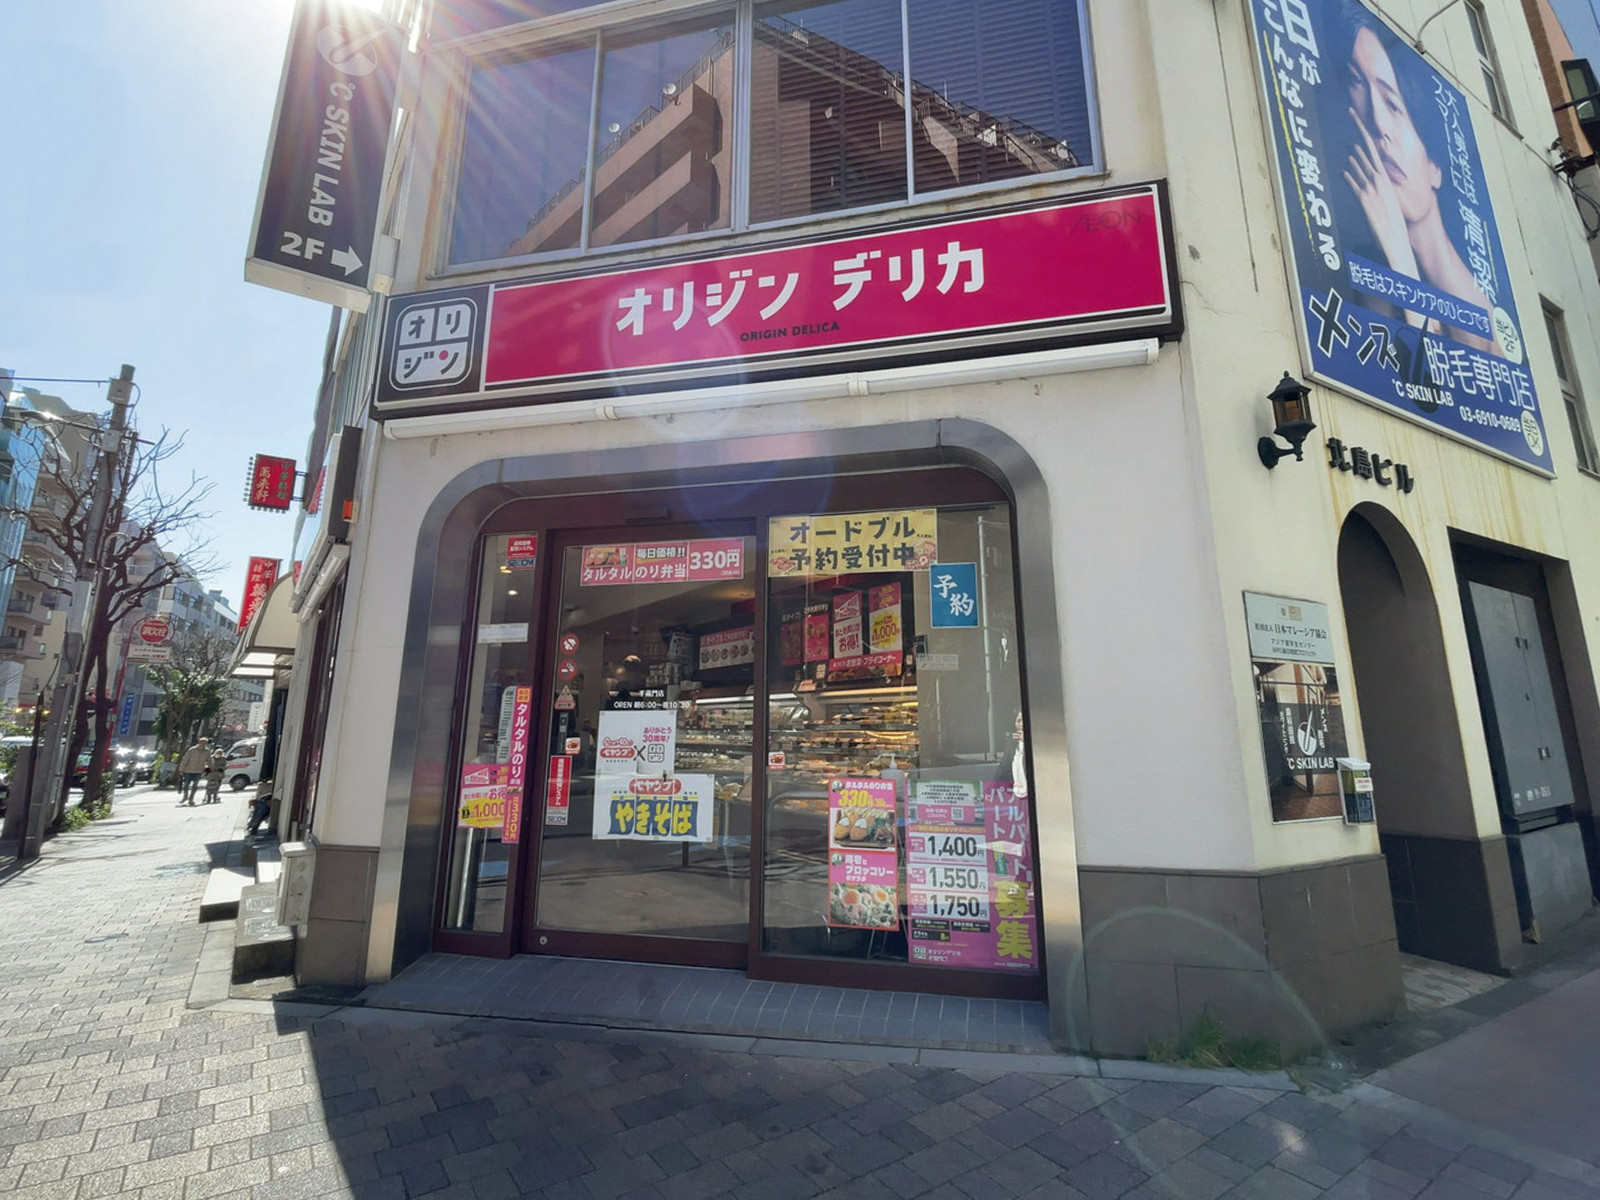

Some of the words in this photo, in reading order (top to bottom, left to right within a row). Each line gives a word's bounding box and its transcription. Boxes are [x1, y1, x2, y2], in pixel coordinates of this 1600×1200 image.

[317, 104, 351, 176] SKIN
[308, 174, 339, 228] LAB
[280, 231, 326, 260] 2F
[616, 268, 802, 337] オリジン
[832, 239, 986, 313] デリカ
[1348, 261, 1491, 335] 脱毛はスキンケアのひとつです
[739, 328, 788, 342] ORIGIN
[791, 321, 841, 337] DELICA
[1422, 336, 1535, 412] 脱毛専門店
[1406, 384, 1433, 404] SKIN
[1432, 388, 1455, 408] LAB
[1326, 436, 1415, 494] 北島ビル
[789, 516, 917, 544] オードブル
[690, 550, 741, 571] 330円
[789, 541, 916, 571] 予約受付中
[582, 562, 687, 582] タルタルのり弁当
[933, 574, 975, 617] 予約
[613, 700, 633, 709] OPEN
[642, 726, 673, 735] ありがとう
[1296, 757, 1318, 770] SKIN
[1318, 757, 1335, 769] LAB
[615, 801, 693, 836] やきそば
